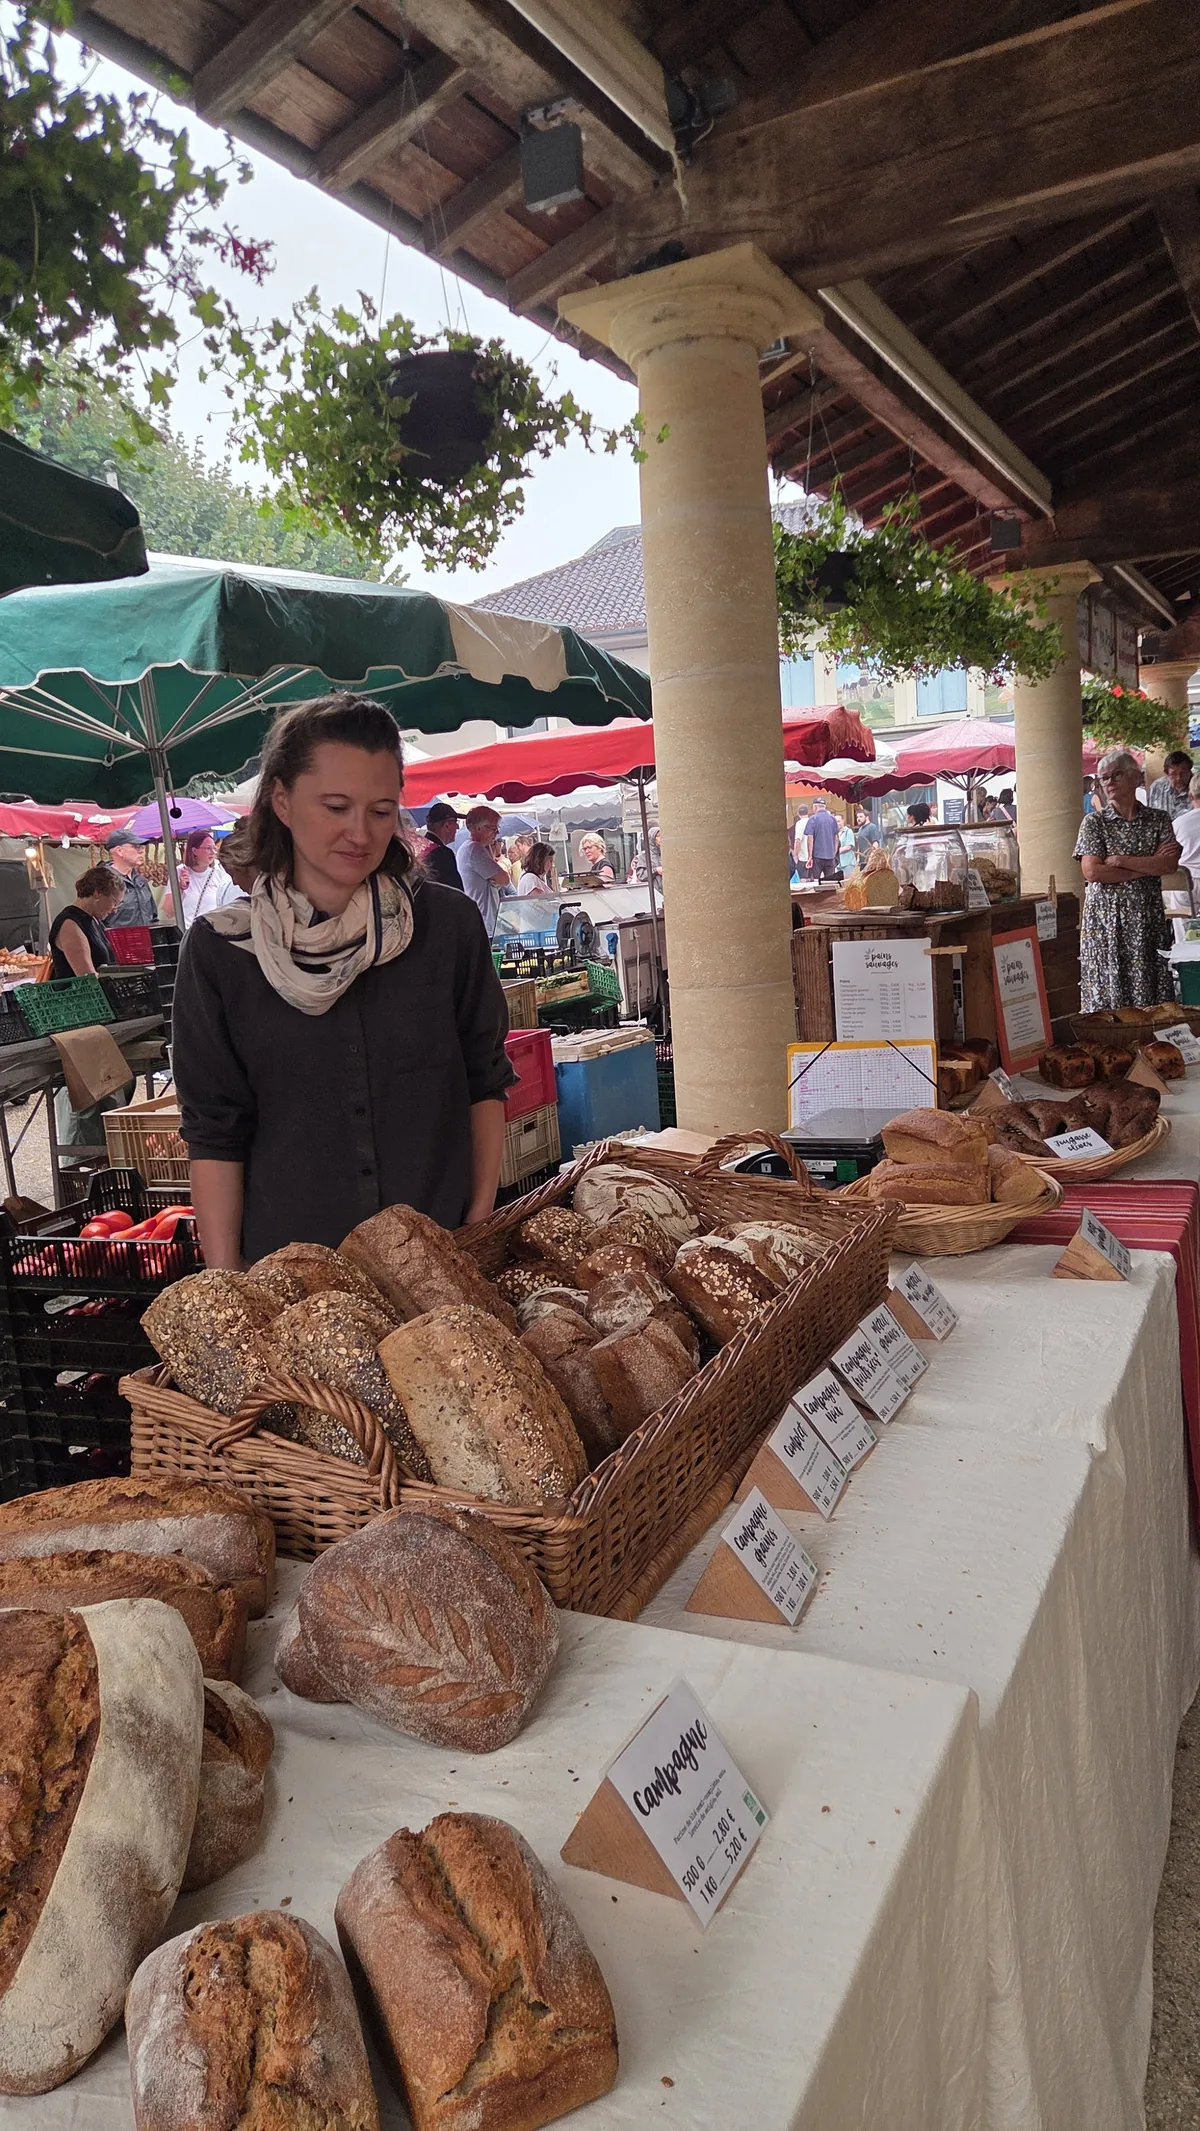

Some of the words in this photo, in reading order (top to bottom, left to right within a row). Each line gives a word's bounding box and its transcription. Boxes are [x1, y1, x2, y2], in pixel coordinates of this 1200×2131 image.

[840, 1341, 875, 1379] Campagne
[803, 1381, 840, 1415] Campagne
[825, 1400, 844, 1424] noix
[783, 1421, 808, 1458] Complet
[734, 1503, 768, 1551] Campagne
[754, 1528, 778, 1568] graines
[774, 1590, 785, 1606] 500
[633, 1719, 707, 1816] Campagne
[682, 1864, 700, 1892] 500
[696, 1855, 705, 1871] G
[712, 1817, 730, 1845] 2,80
[726, 1808, 735, 1822] €
[724, 1836, 742, 1865] 5,20
[738, 1828, 747, 1842] €
[700, 1889, 709, 1904] 1
[704, 1876, 718, 1898] KG
